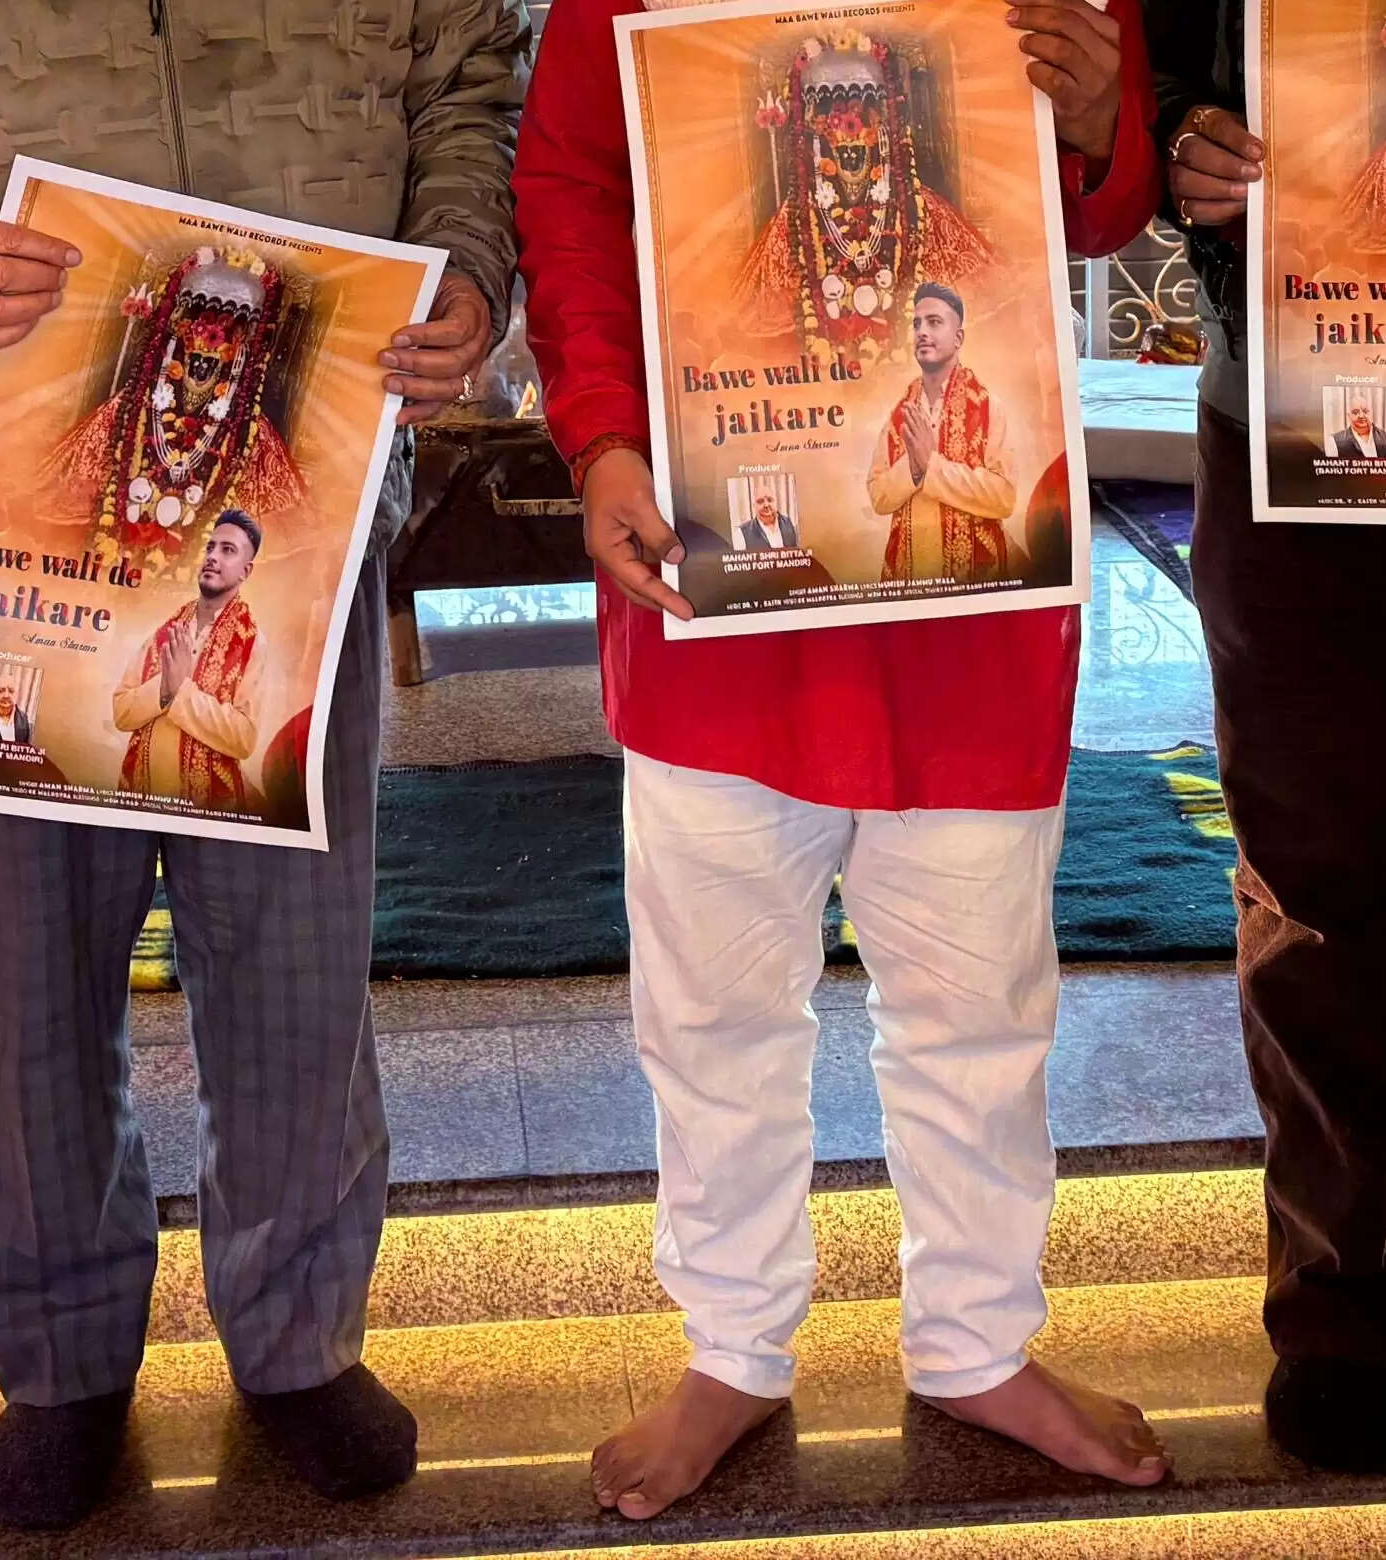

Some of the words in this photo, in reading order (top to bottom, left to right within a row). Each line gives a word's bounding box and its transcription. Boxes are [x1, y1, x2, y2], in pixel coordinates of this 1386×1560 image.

[796, 12, 819, 22] BAWE
[820, 10, 841, 19] WALI
[842, 6, 880, 18] RECORDS
[178, 216, 198, 226] MAA
[200, 220, 224, 232] BAWE
[226, 226, 247, 237] WALI
[248, 232, 287, 247] RECORDS
[1283, 275, 1360, 301] Bawe
[682, 365, 755, 392] Bawe
[763, 352, 822, 387] wali
[829, 351, 862, 381] de
[1335, 374, 1377, 383] Producer
[711, 399, 845, 446] jaikare
[737, 462, 780, 474] Producer
[1315, 467, 1342, 475] (BAHU
[722, 552, 757, 562] MAHANT
[759, 551, 779, 560] SHRI
[780, 549, 804, 558] BITTA
[805, 548, 812, 556] JI
[38, 550, 104, 582] wali
[107, 556, 143, 589] de
[724, 562, 750, 572] (BAHU
[752, 561, 774, 570] FORT
[775, 558, 811, 568] MANDIR)
[21, 631, 56, 646] Aman
[59, 636, 98, 652] Sharma
[10, 744, 36, 754] BITTA
[4, 752, 44, 764] MANDIR)
[38, 781, 62, 790] AMAN
[62, 784, 94, 793] SHARMA
